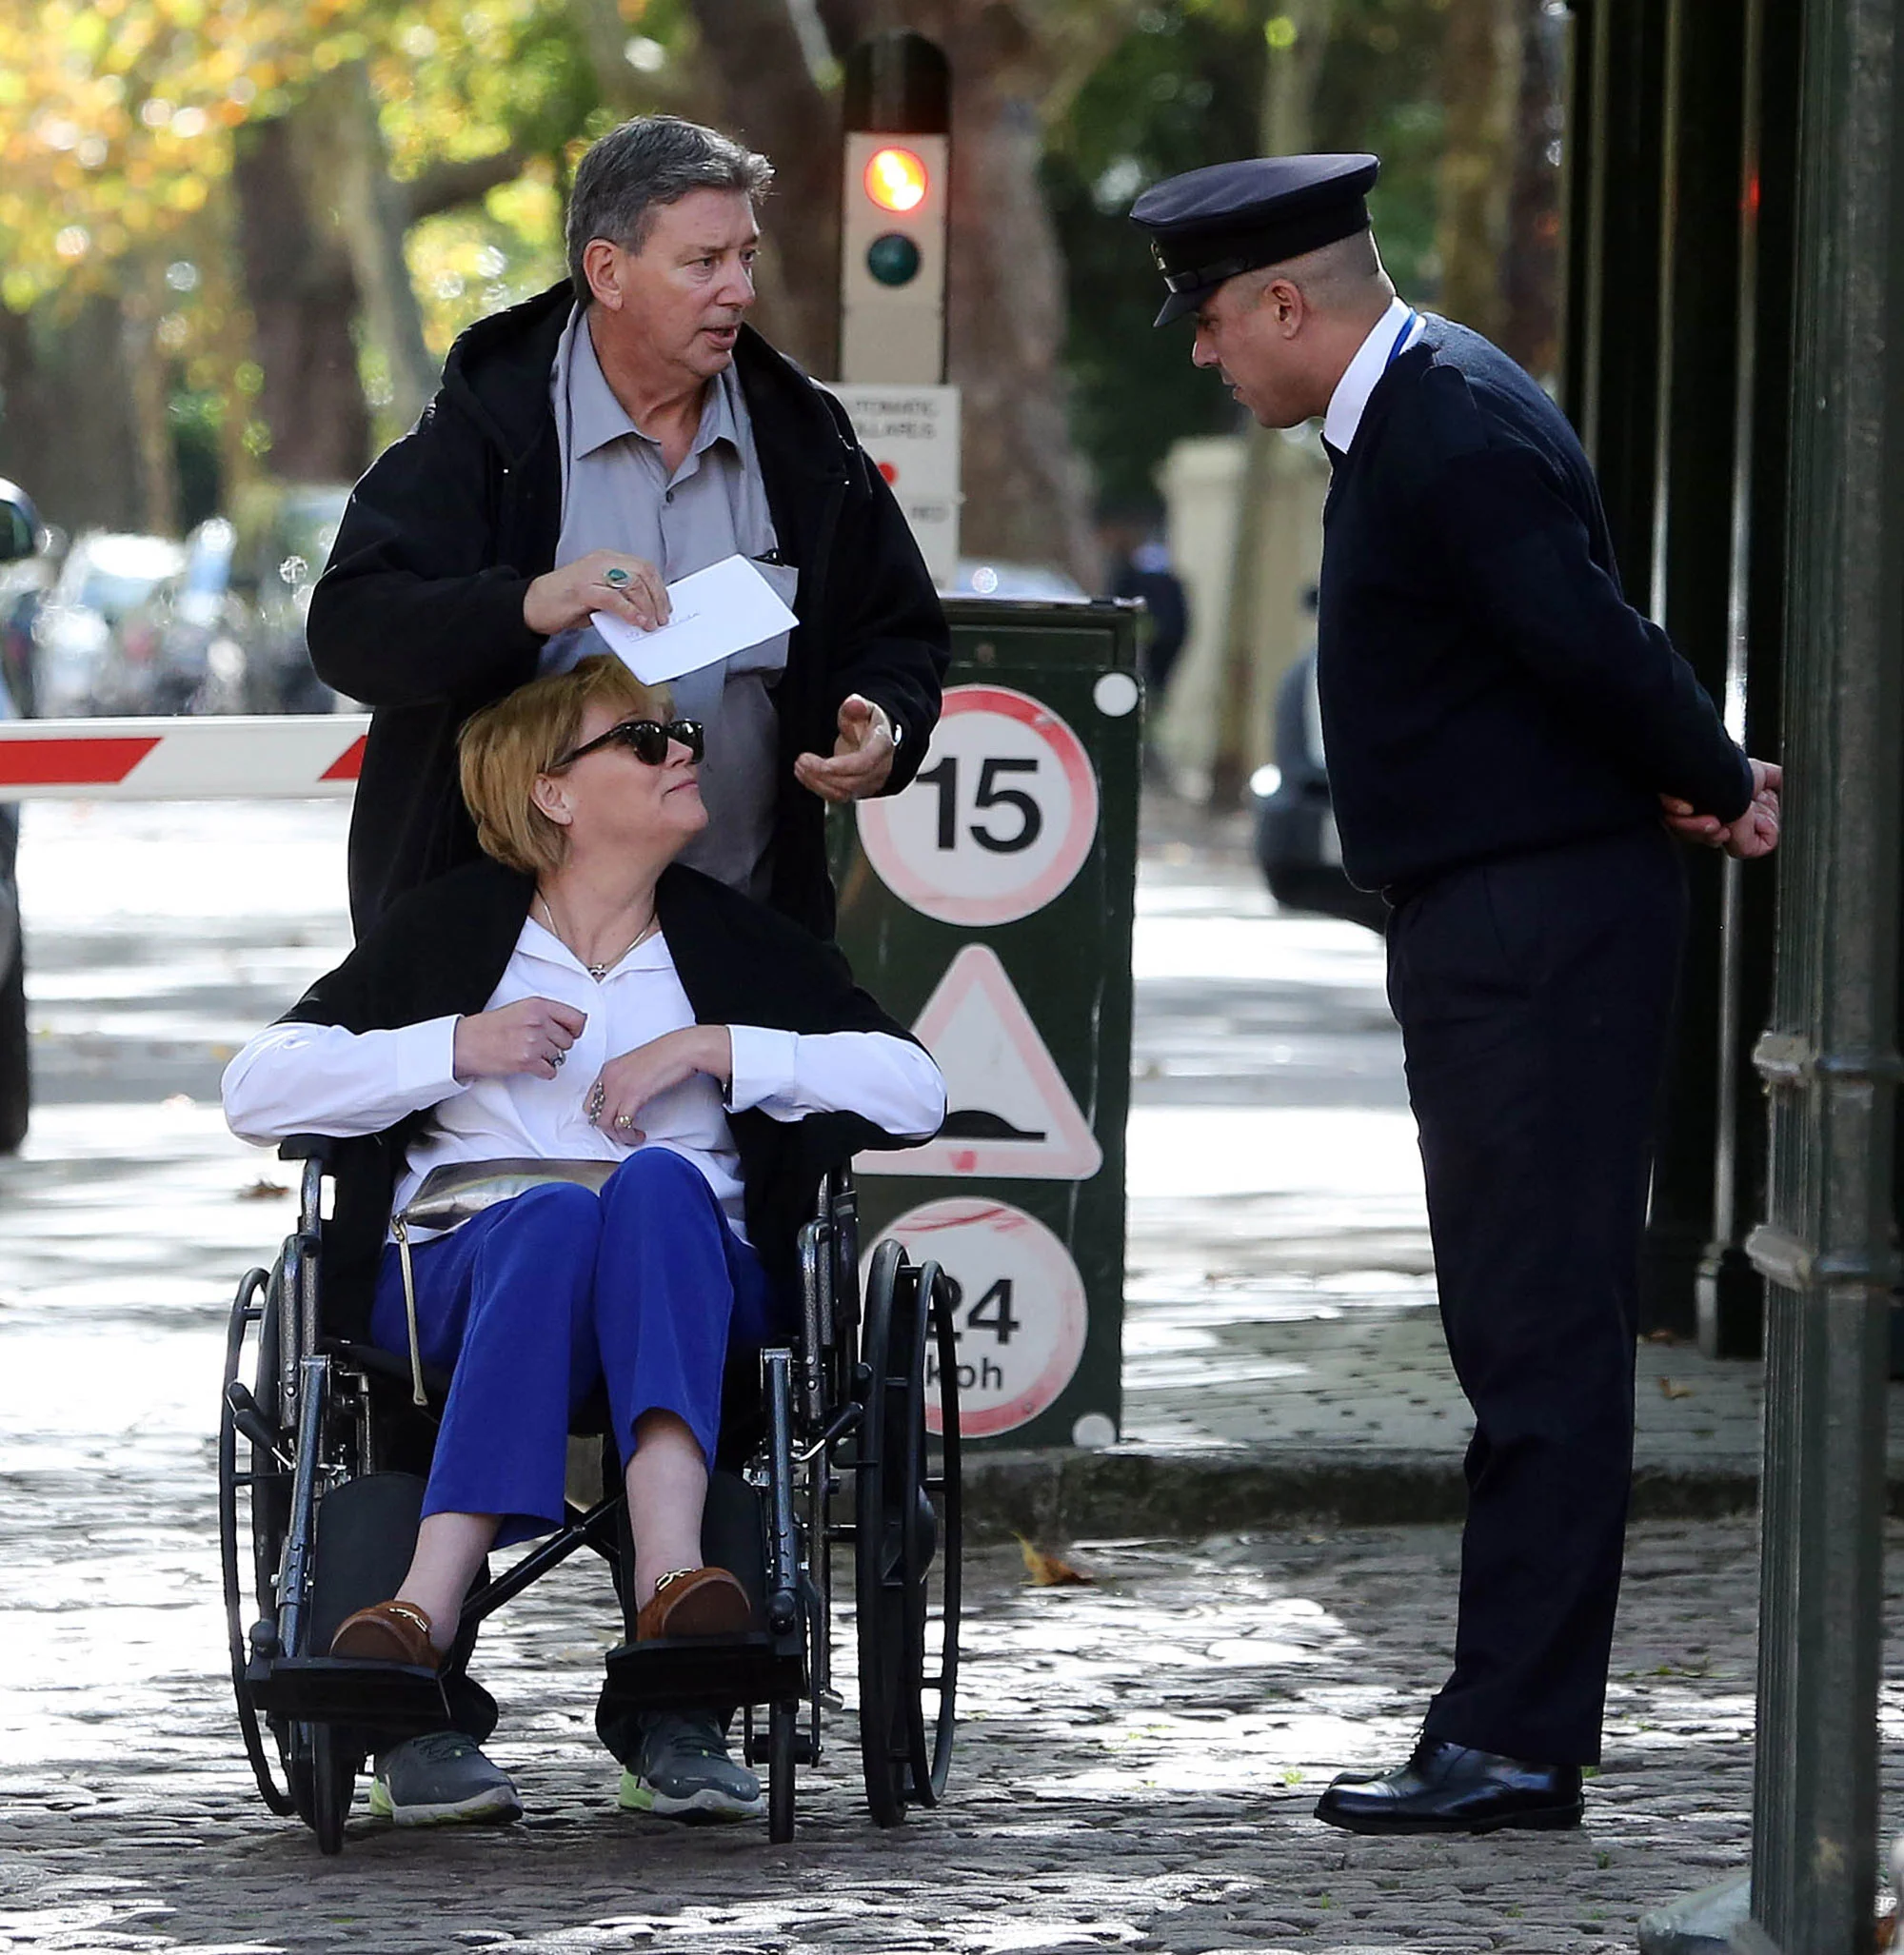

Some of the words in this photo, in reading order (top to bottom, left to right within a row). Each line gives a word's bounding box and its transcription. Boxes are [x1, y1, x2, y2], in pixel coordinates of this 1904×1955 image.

[843, 399, 937, 416] UTOMATIC
[915, 757, 1042, 854] 15
[924, 1275, 1021, 1345] 24
